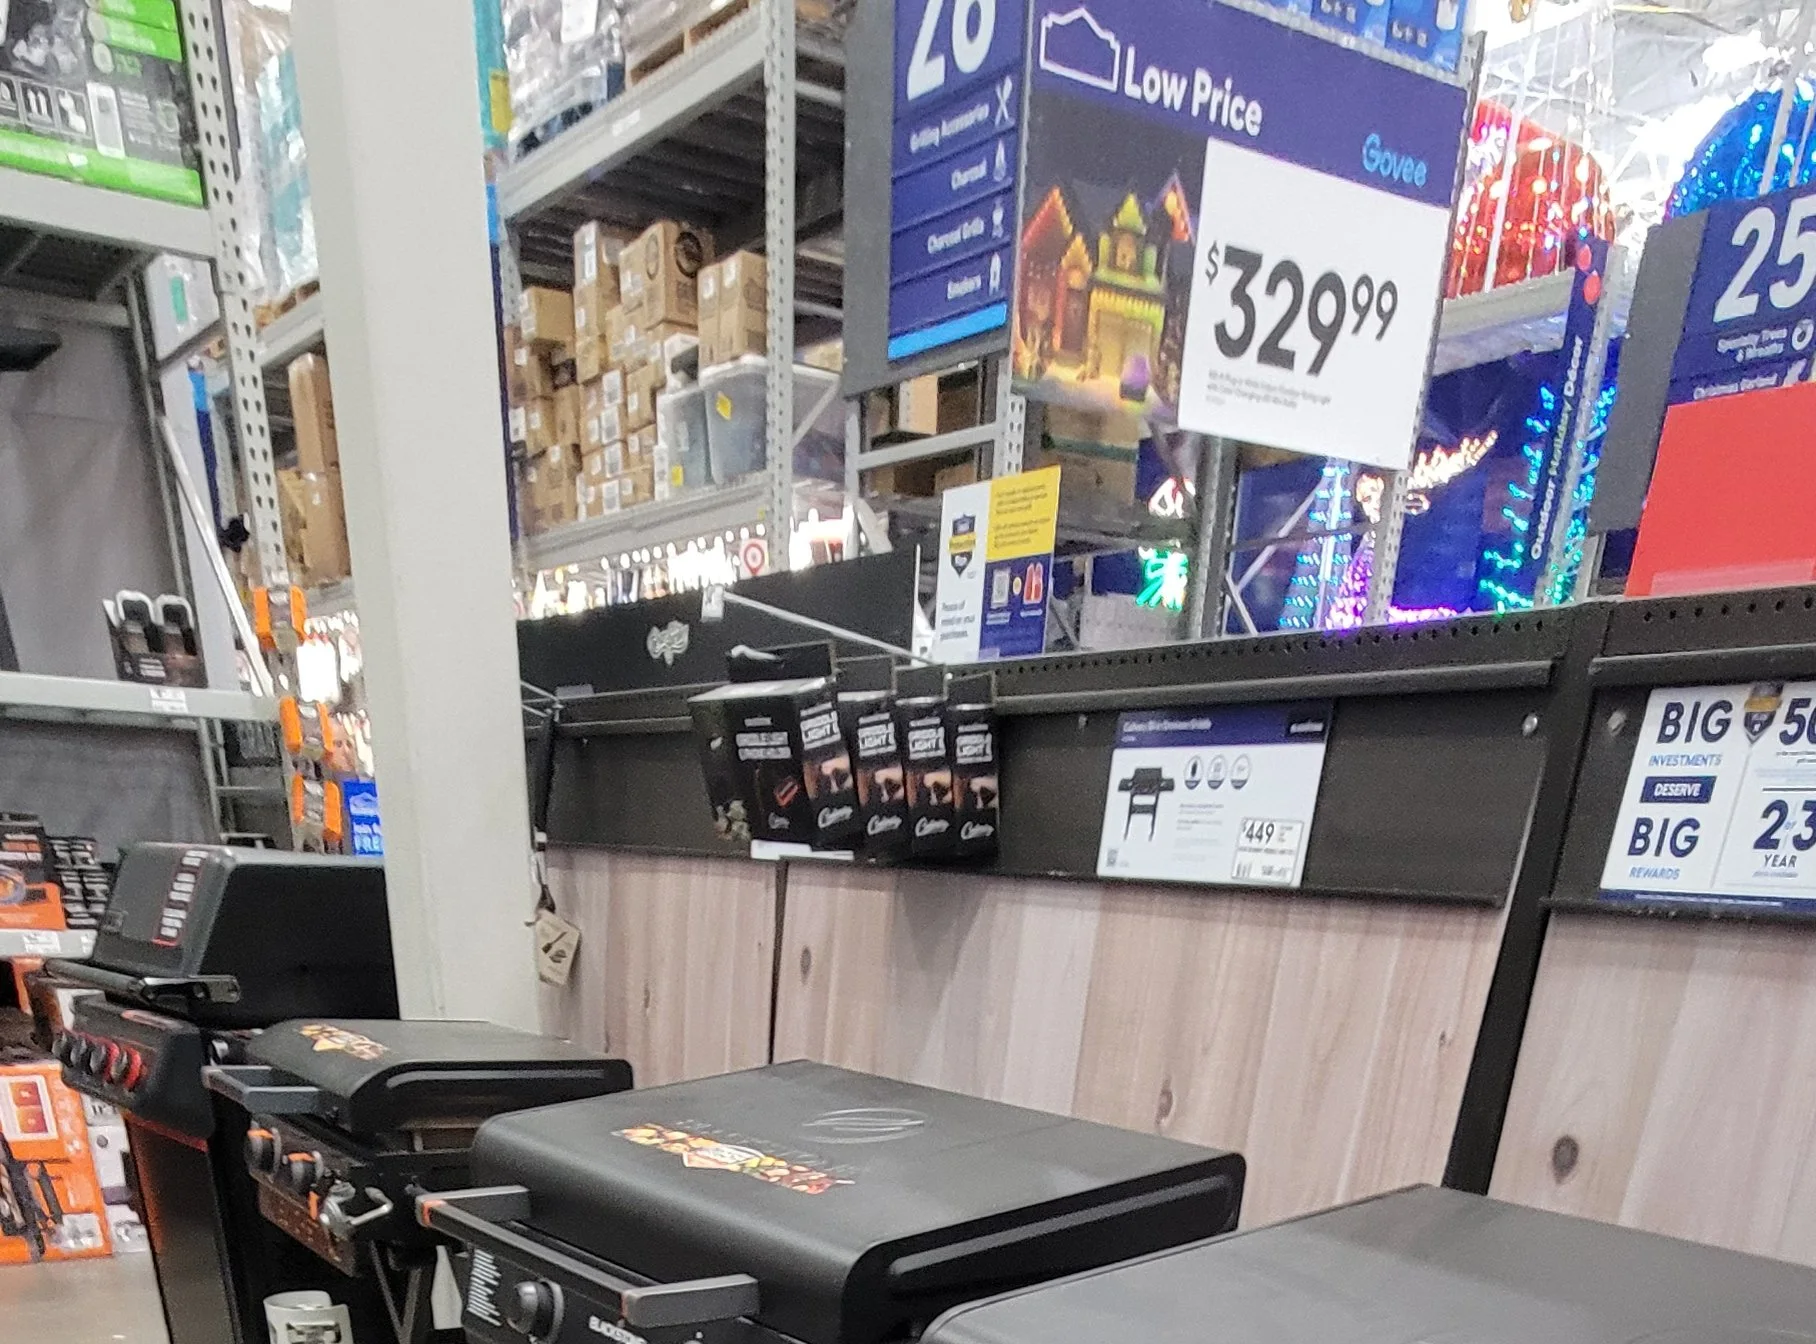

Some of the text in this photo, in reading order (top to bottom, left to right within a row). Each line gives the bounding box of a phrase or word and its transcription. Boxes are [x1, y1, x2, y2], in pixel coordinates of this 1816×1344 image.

[1124, 44, 1263, 137] Low Price
[1362, 132, 1427, 188] Govee
[1712, 192, 1816, 324] 25
[1530, 477, 1557, 561] Outdoor
[1548, 398, 1575, 476] Holiday
[1656, 699, 1734, 744] BIG
[1648, 754, 1723, 767] INVESTMENTS
[1653, 782, 1702, 797] DESERVE
[1627, 816, 1701, 858] BIG
[1629, 866, 1681, 880] REWARDS
[1763, 853, 1798, 868] YEAR
